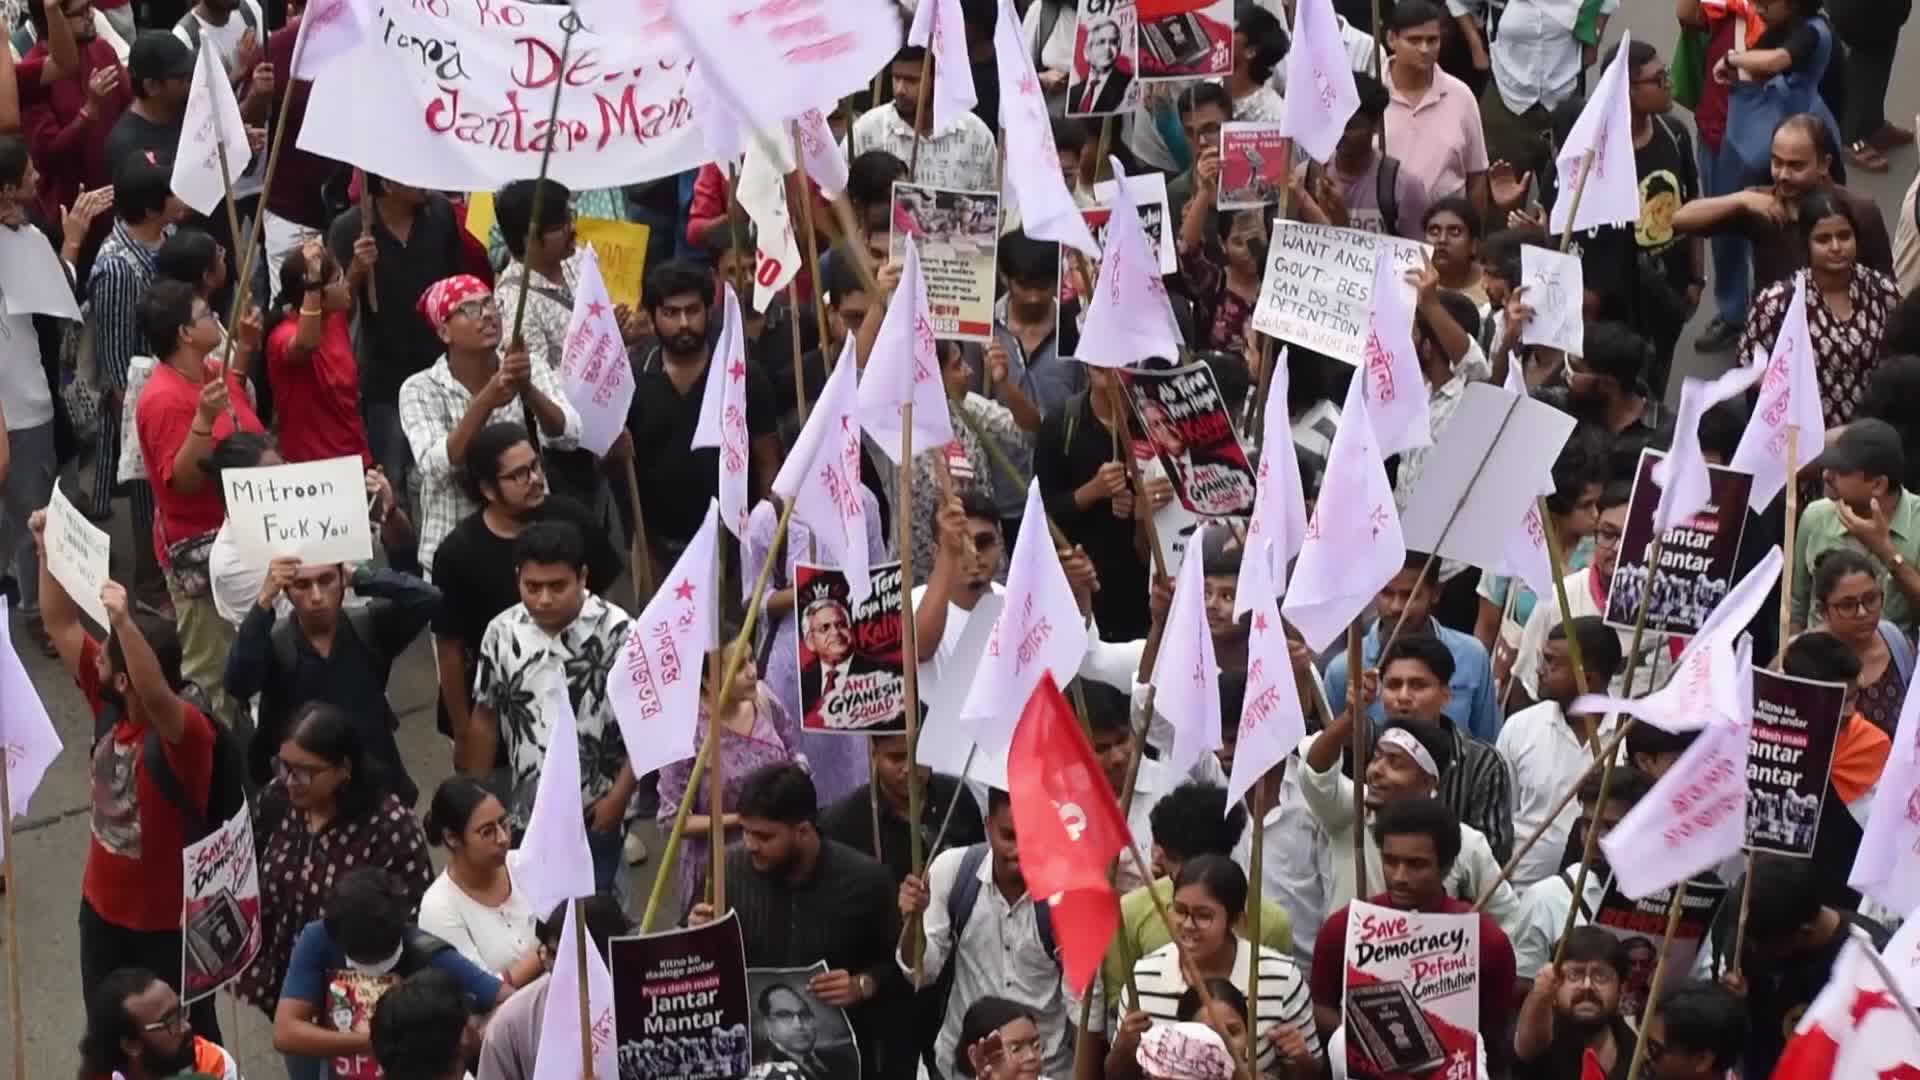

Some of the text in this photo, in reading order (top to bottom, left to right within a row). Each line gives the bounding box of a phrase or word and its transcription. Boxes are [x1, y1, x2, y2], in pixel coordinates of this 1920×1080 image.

[1281, 232, 1330, 260] WANT
[1273, 277, 1352, 317] CAN DO IS
[1336, 277, 1369, 301] BES
[1269, 293, 1361, 337] DETENTION
[232, 478, 335, 504] Mitroon
[1661, 527, 1715, 550] antar
[828, 681, 902, 715] GYANESH
[842, 675, 879, 693] ANTI
[849, 697, 895, 724] SQUAD
[1746, 739, 1804, 765] antar
[1746, 762, 1804, 788] antar
[1360, 913, 1410, 943] Save
[1355, 927, 1470, 968] Democracy,
[1411, 952, 1467, 982] Defend
[1411, 970, 1477, 1001] Constitution
[649, 989, 718, 1017] Jantar
[643, 1009, 724, 1035] Mantar
